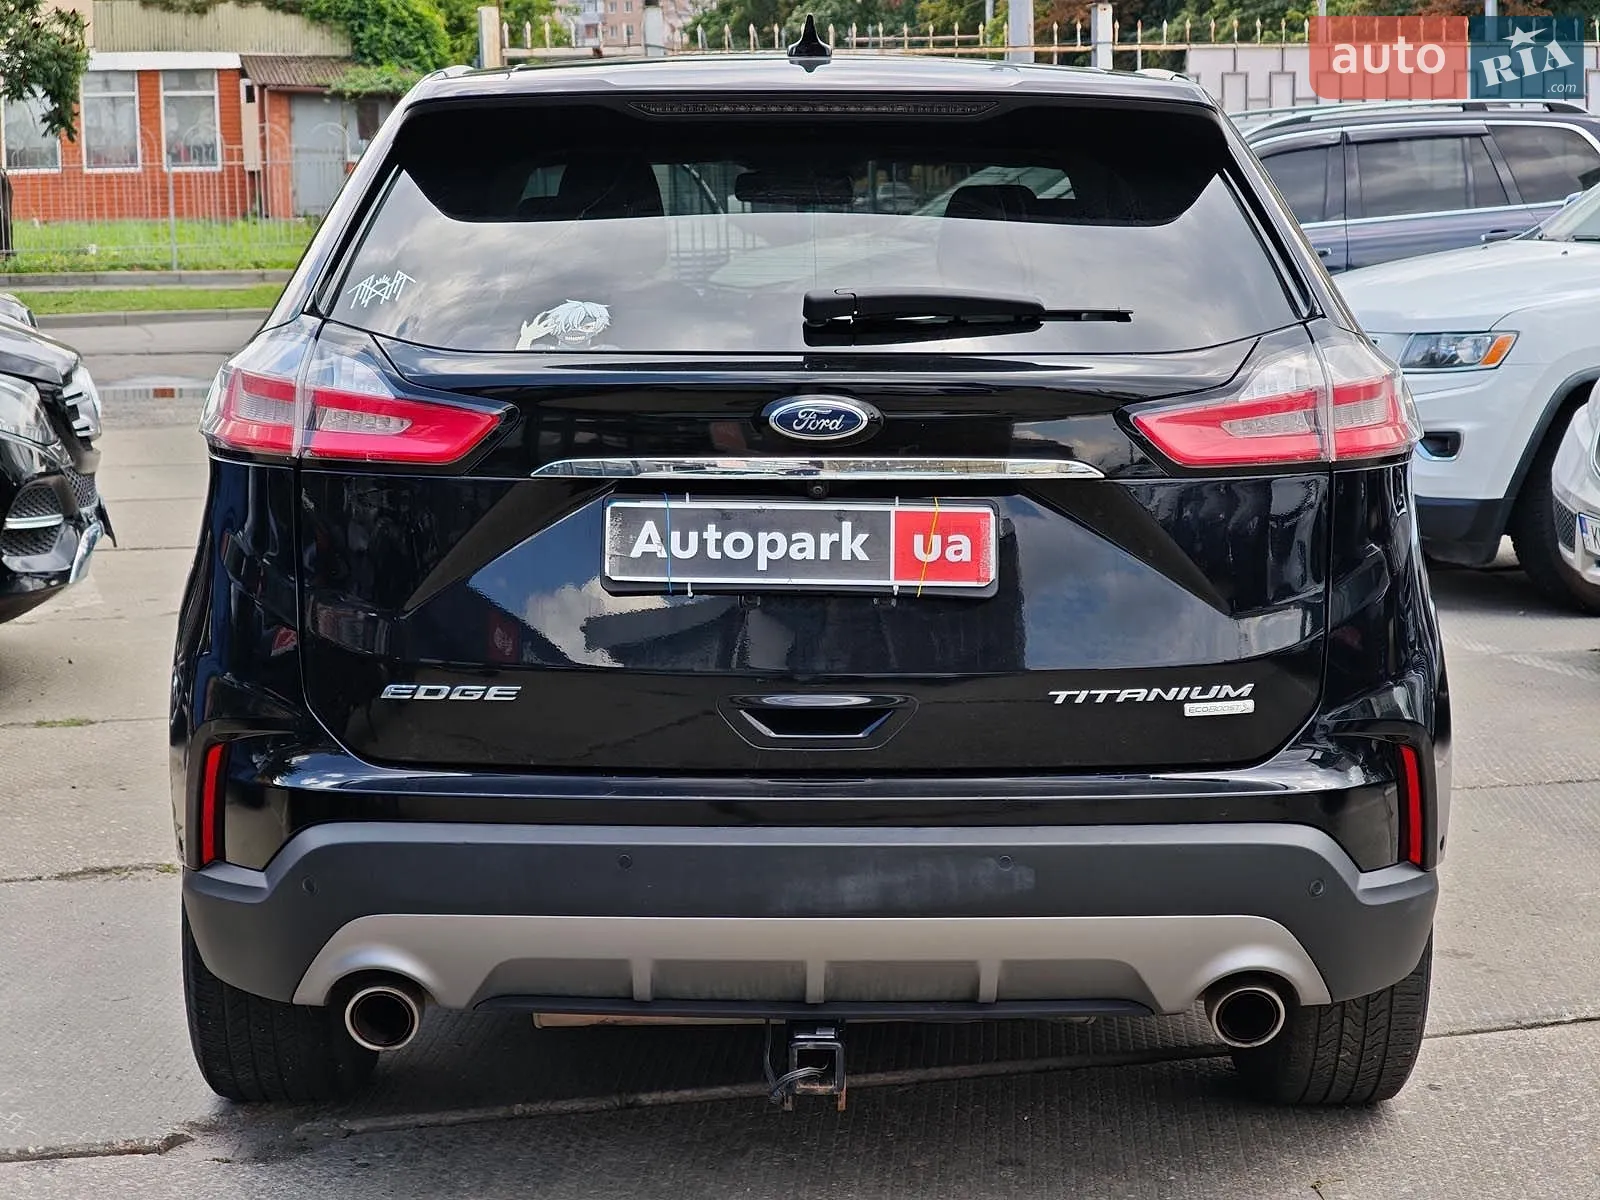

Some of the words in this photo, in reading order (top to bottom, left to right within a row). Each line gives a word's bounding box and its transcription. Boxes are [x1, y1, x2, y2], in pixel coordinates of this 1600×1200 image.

[792, 408, 846, 431] Ford
[629, 520, 870, 571] Autopark
[912, 533, 972, 563] ua
[380, 684, 522, 701] EDGE
[1048, 683, 1255, 705] TITANIUM
[1188, 704, 1242, 713] ECOBOOST
